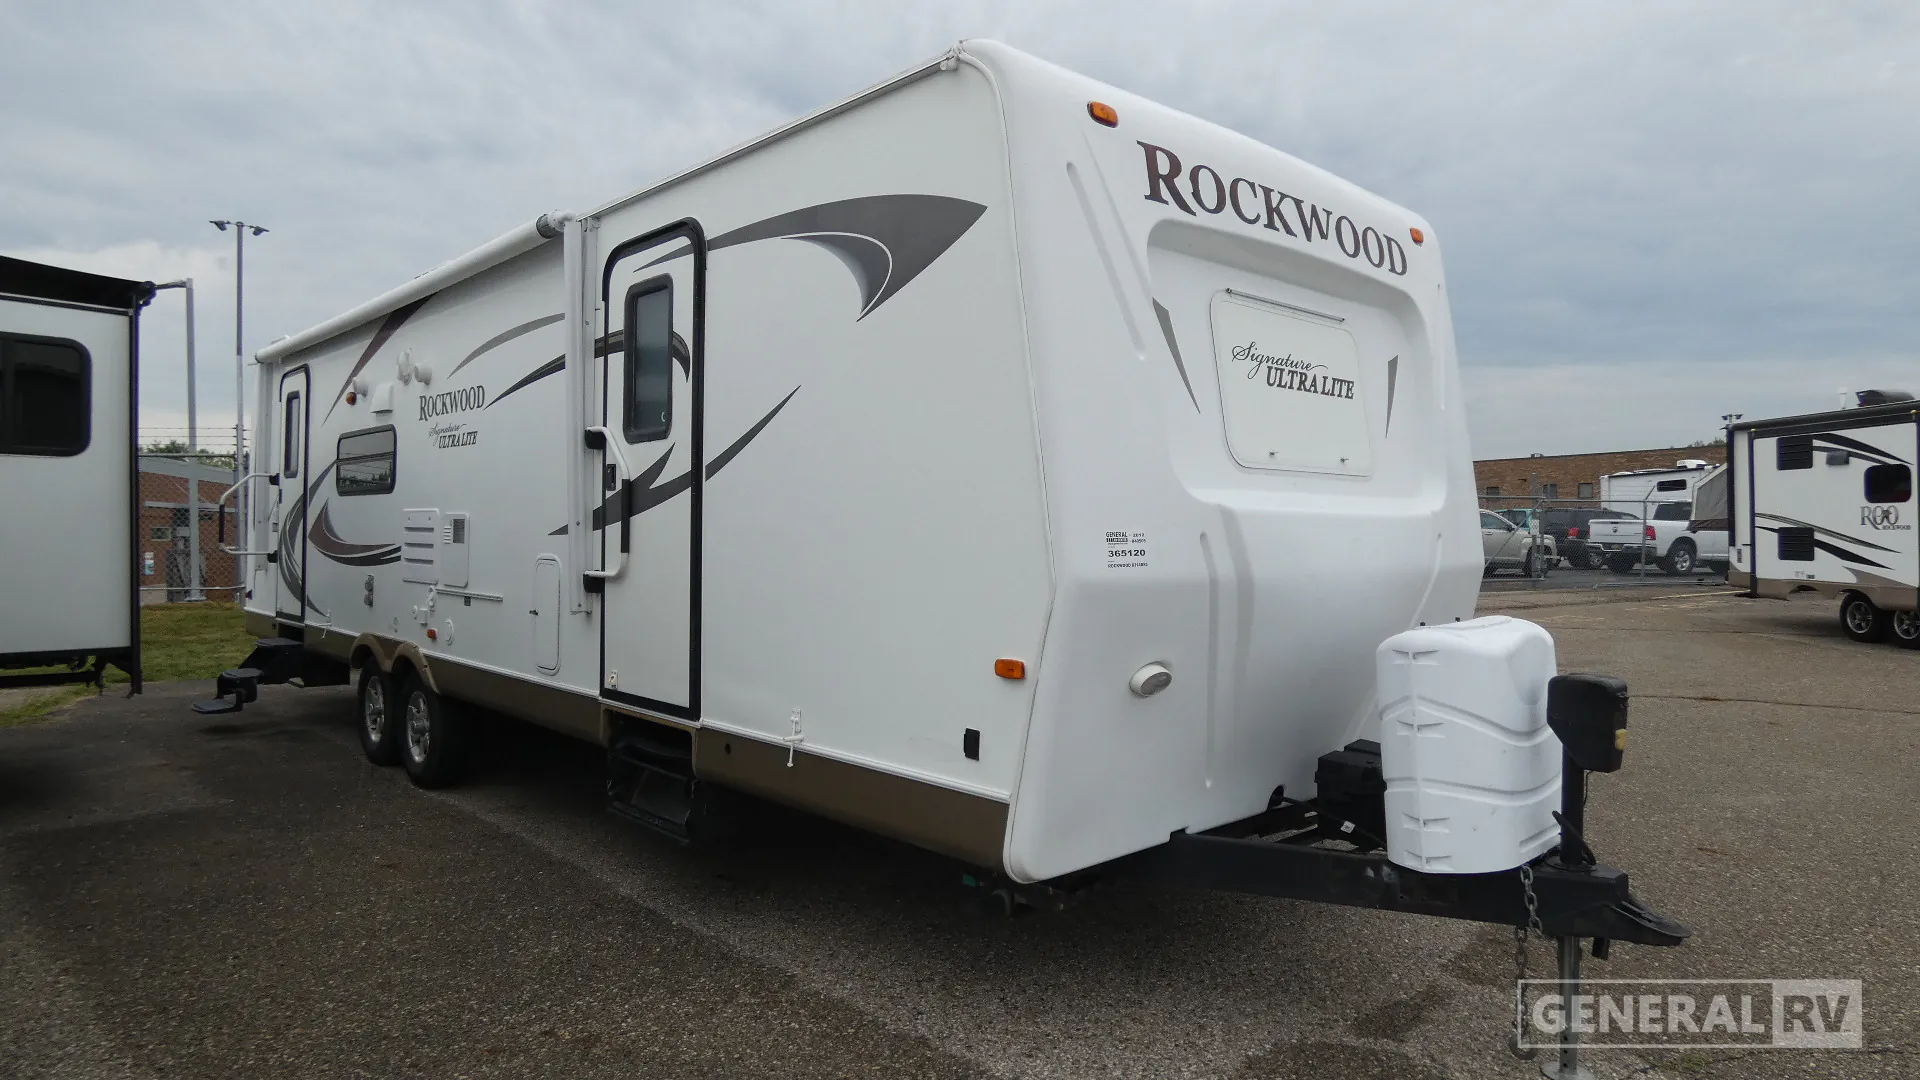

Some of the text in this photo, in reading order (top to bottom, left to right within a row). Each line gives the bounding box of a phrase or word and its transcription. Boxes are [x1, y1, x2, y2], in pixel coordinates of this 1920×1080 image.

[1136, 140, 1408, 276] ROCKWOOD
[1231, 341, 1329, 380] Signature
[419, 385, 485, 421] ROCKWOOD
[428, 422, 467, 447] Signature
[1107, 549, 1146, 558] 365120
